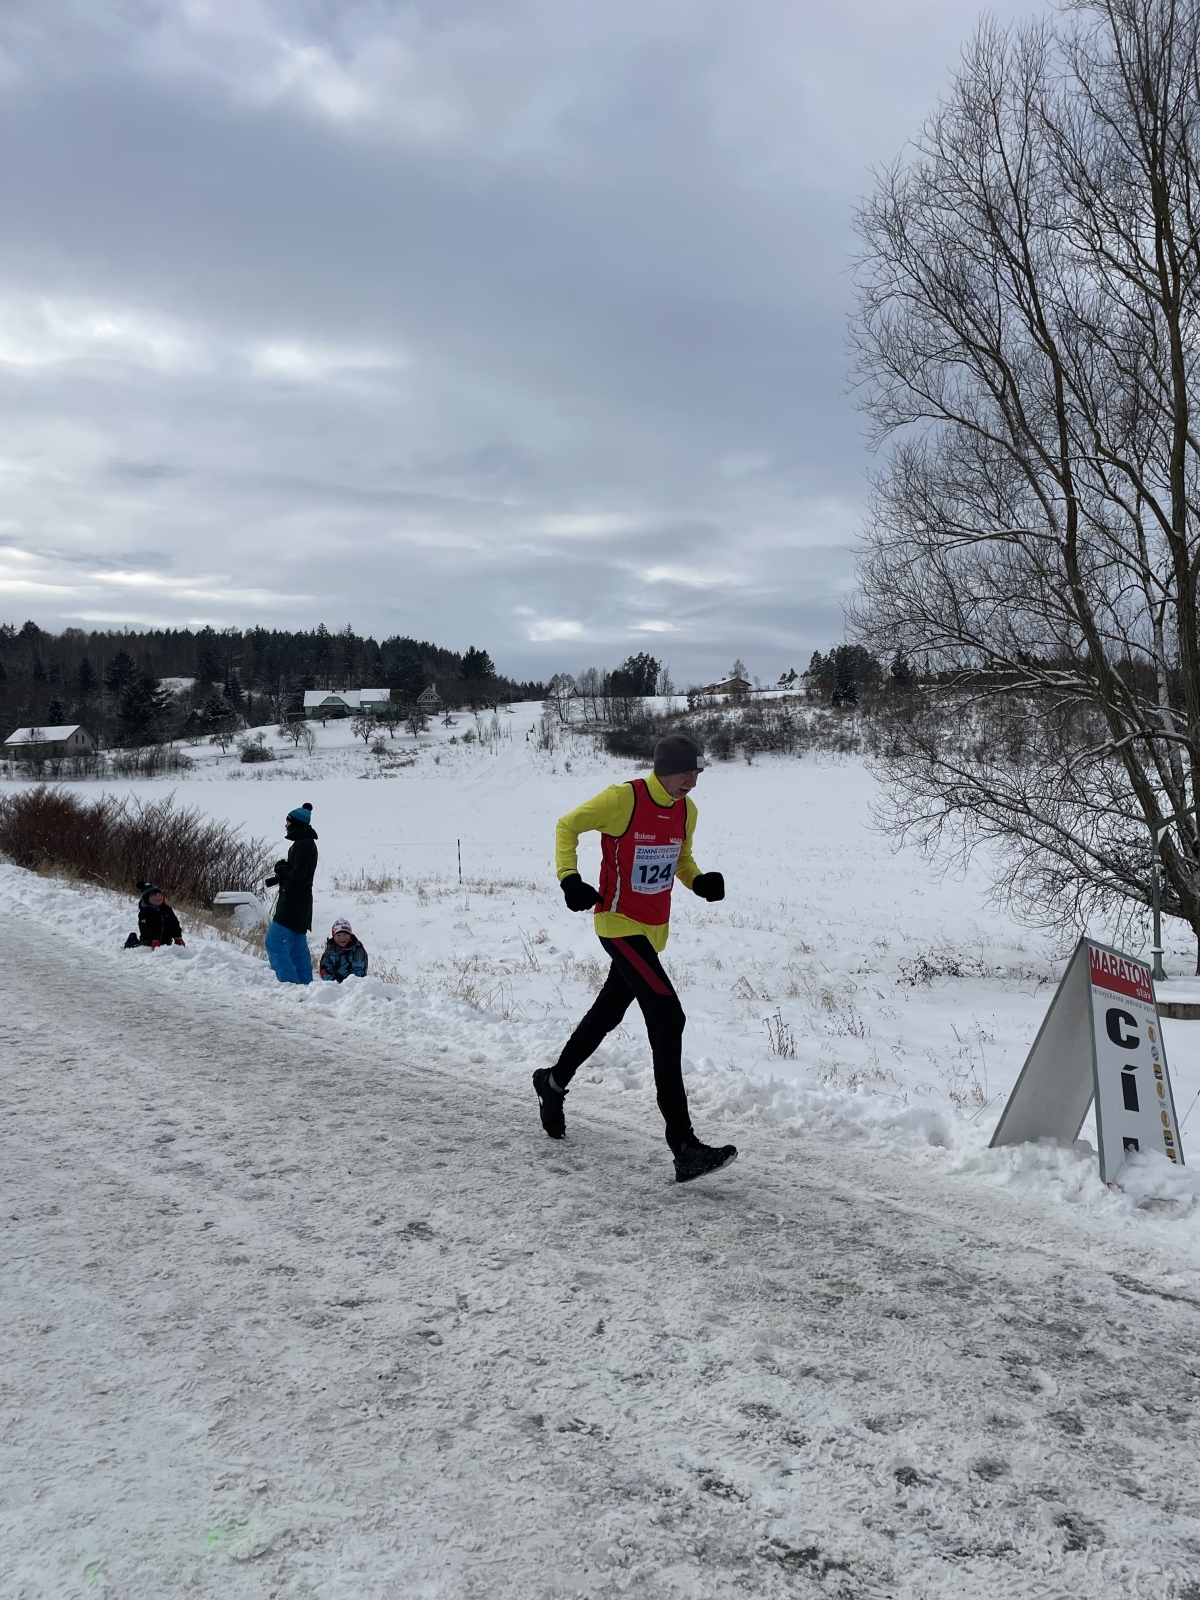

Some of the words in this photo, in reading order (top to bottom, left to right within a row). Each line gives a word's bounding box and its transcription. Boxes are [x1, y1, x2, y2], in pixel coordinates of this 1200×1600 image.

[639, 864, 672, 884] 124
[1089, 946, 1150, 989] MARATON
[1136, 988, 1151, 1000] stav
[1105, 1007, 1140, 1153] CÍ
